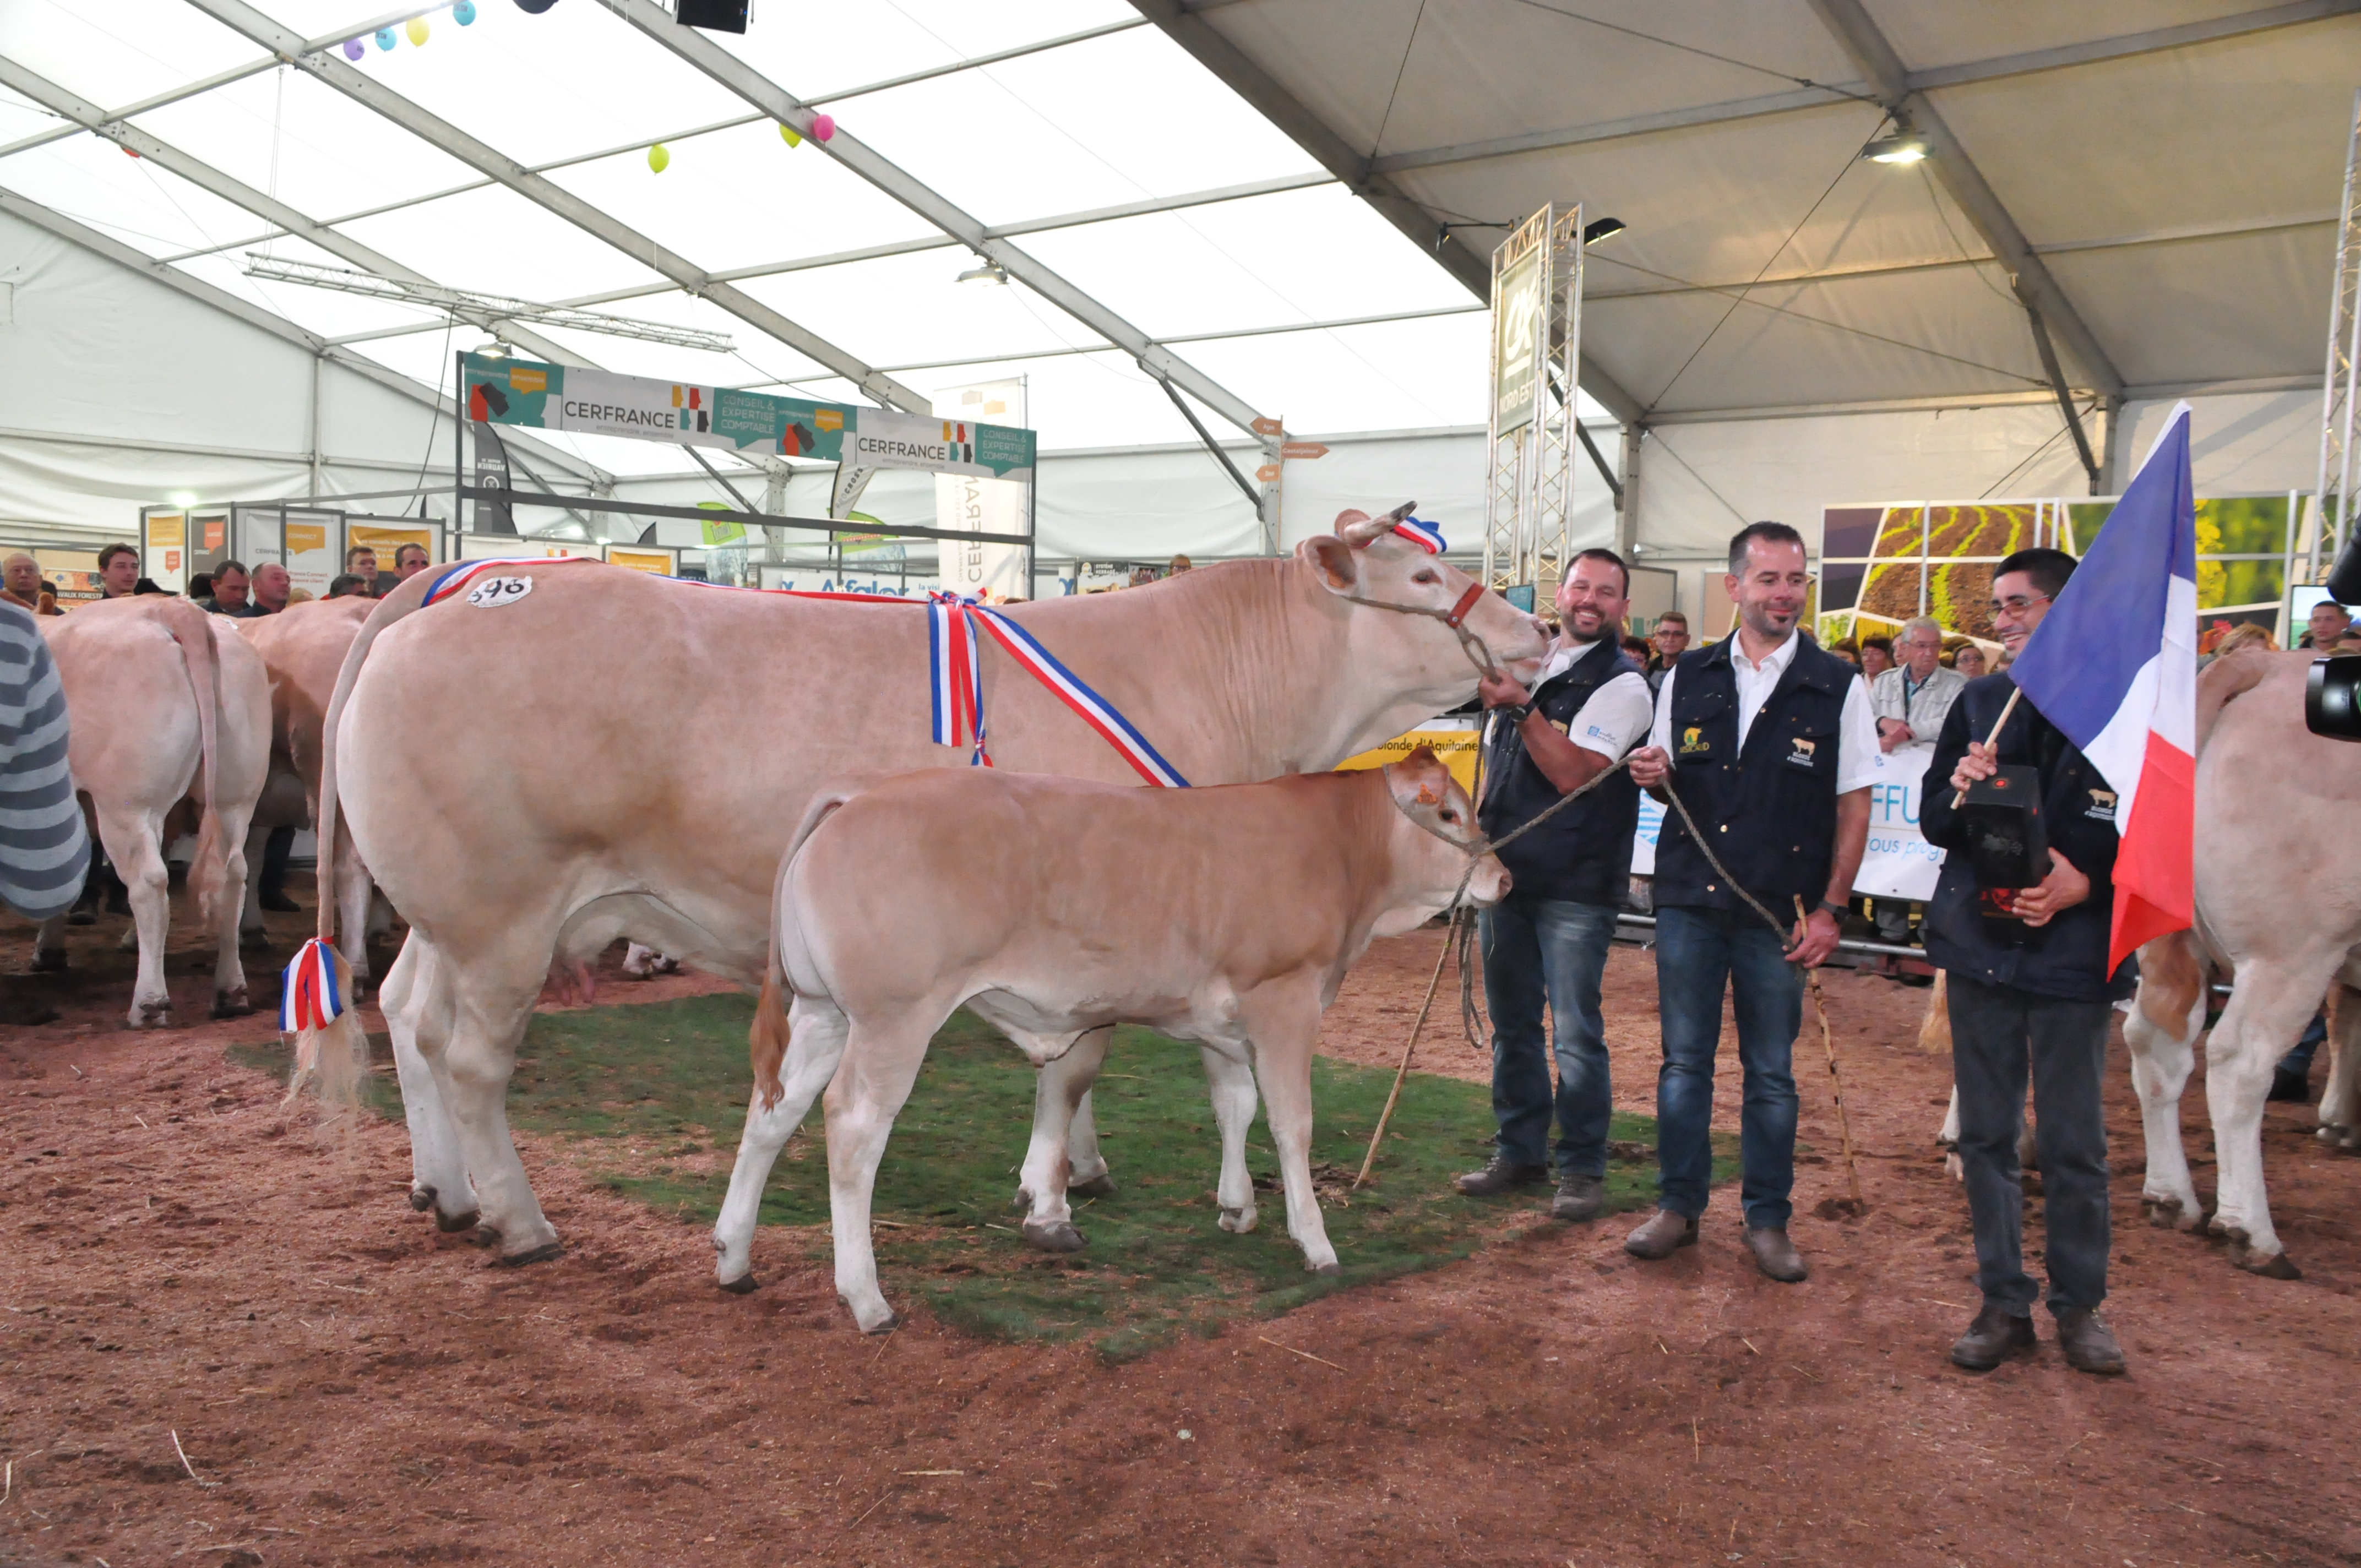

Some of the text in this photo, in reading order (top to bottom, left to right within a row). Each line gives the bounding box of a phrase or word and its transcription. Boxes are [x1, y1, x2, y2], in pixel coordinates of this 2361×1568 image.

[723, 395, 775, 410] CONSEIL &
[1499, 379, 1535, 415] NORD EST
[565, 401, 674, 429] CERFRANCE
[722, 407, 775, 422] EXPERTISE
[721, 420, 775, 434] COMPTABLE
[983, 429, 1019, 442] CONSEIL
[858, 437, 945, 460] CERFRANCE
[983, 440, 1026, 453] EXPERTISE
[982, 450, 1024, 463] COMPTABLE
[467, 579, 525, 603] 396
[1416, 737, 1478, 755] d'Aquitaine
